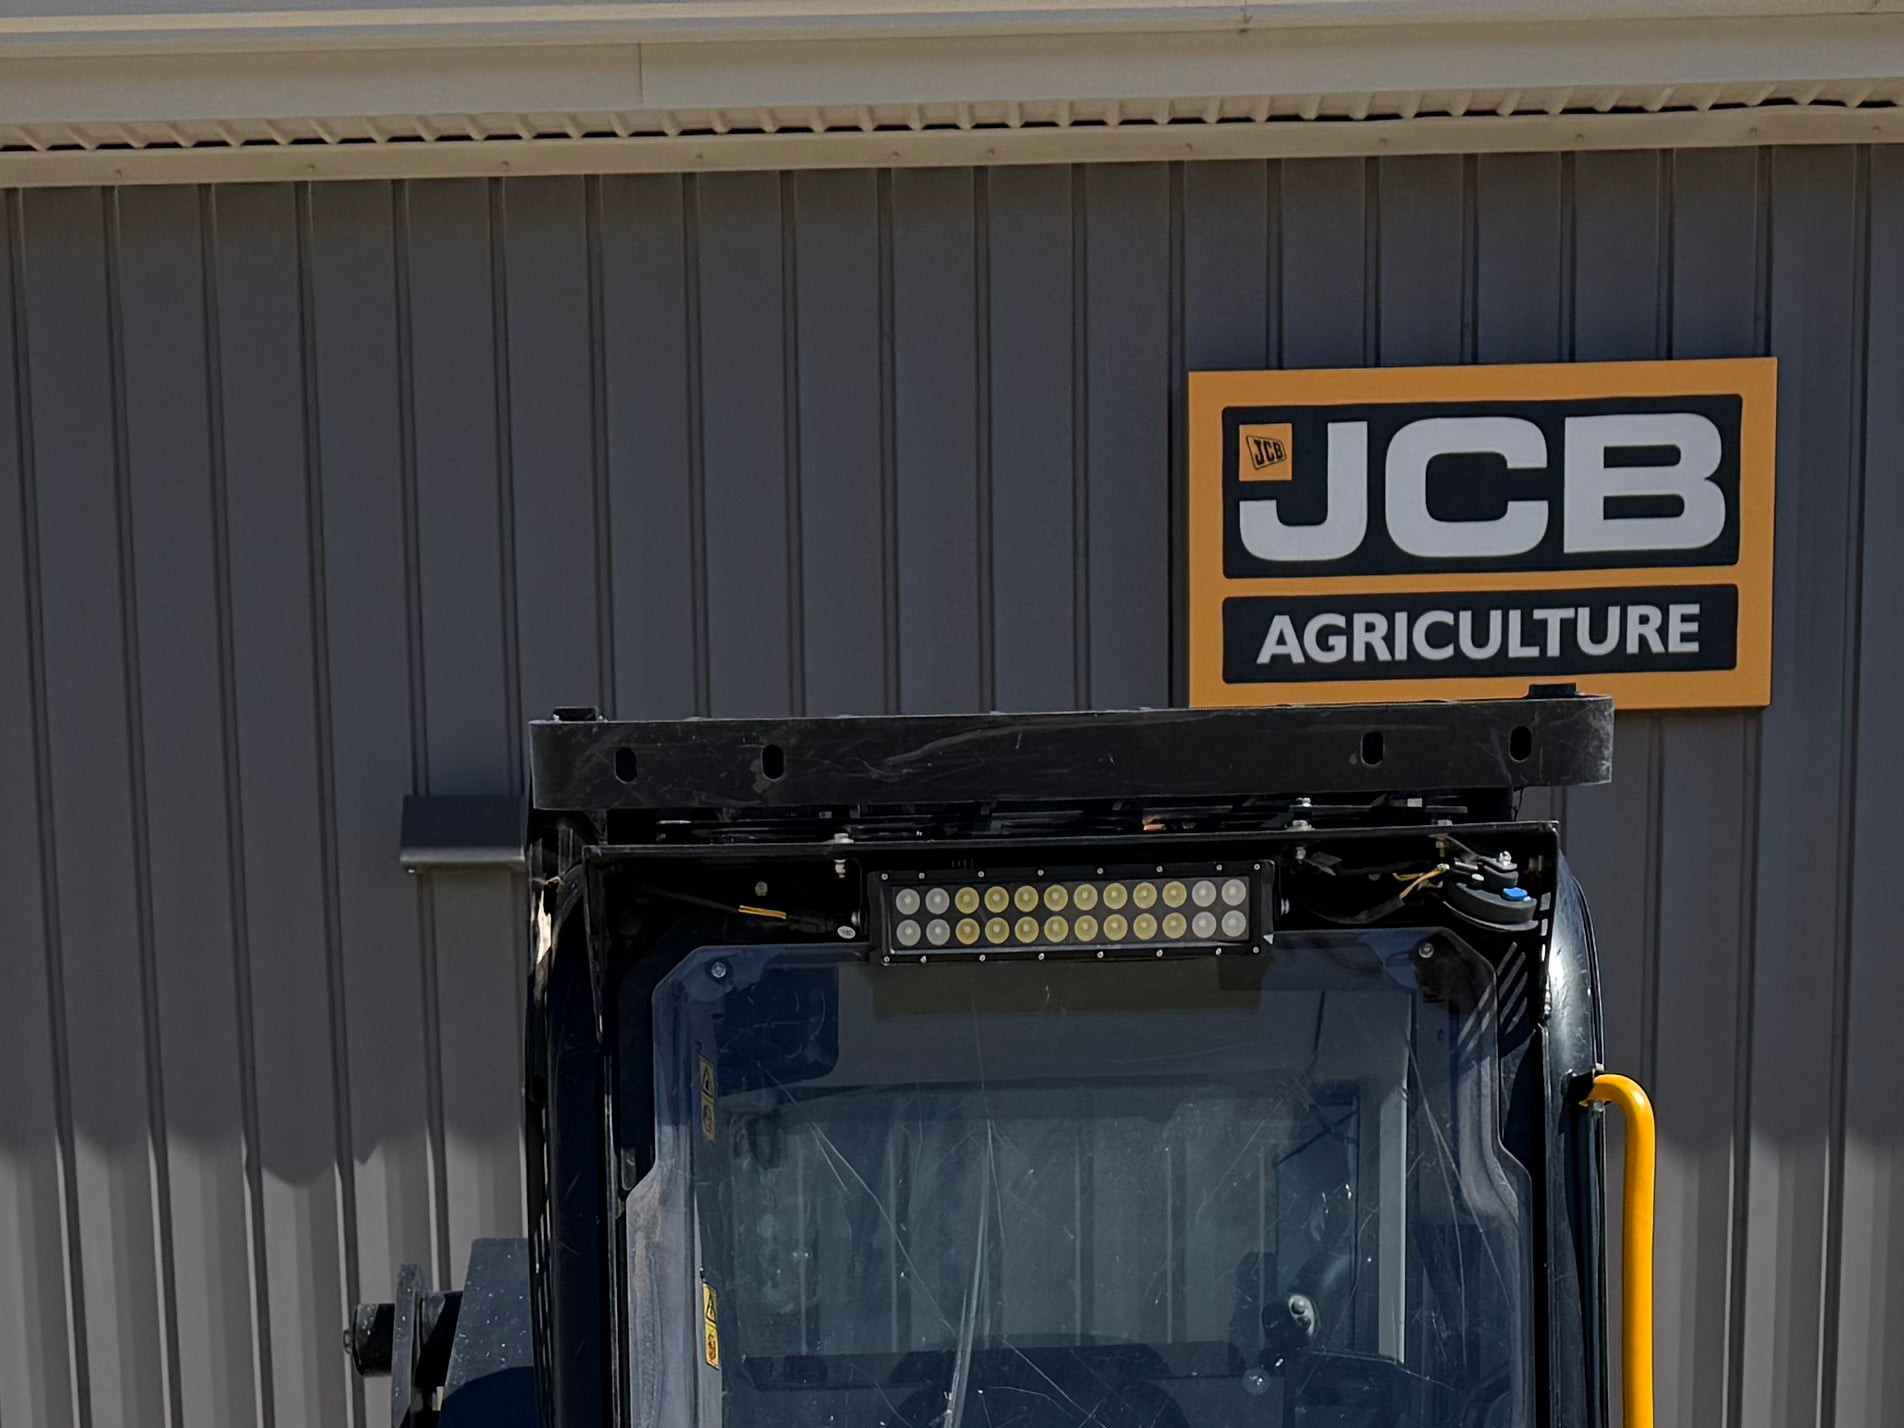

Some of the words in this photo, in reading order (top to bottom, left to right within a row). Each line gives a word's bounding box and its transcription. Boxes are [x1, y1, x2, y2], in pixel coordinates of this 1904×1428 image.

[1253, 438, 1283, 466] JCB
[1239, 413, 1727, 561] JCB
[1256, 603, 1701, 665] AGRICULTURE
